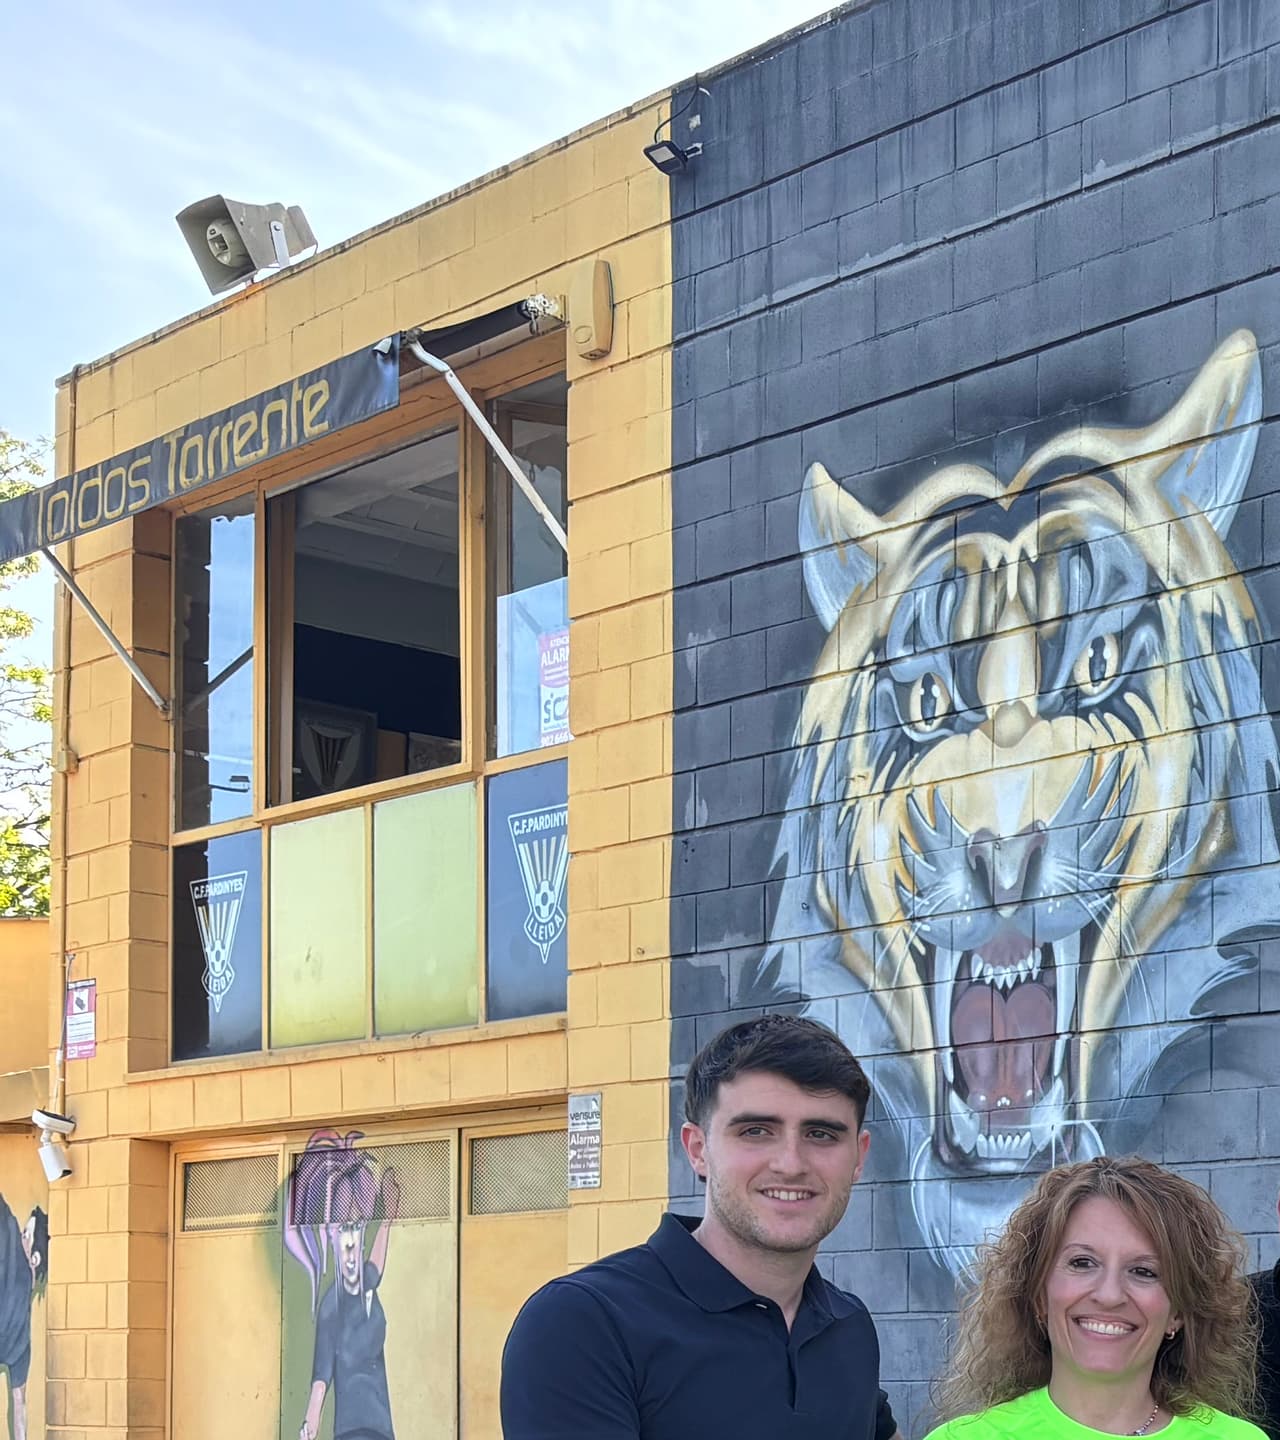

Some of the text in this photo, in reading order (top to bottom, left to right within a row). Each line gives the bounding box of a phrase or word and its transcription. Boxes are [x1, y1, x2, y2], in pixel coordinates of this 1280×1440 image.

[34, 378, 331, 547] Toldos Torrente
[541, 645, 569, 668] ALAR
[513, 810, 568, 835] C.F.PARDINY
[527, 914, 563, 941] LLEIDA
[571, 1132, 600, 1146] Alarma
